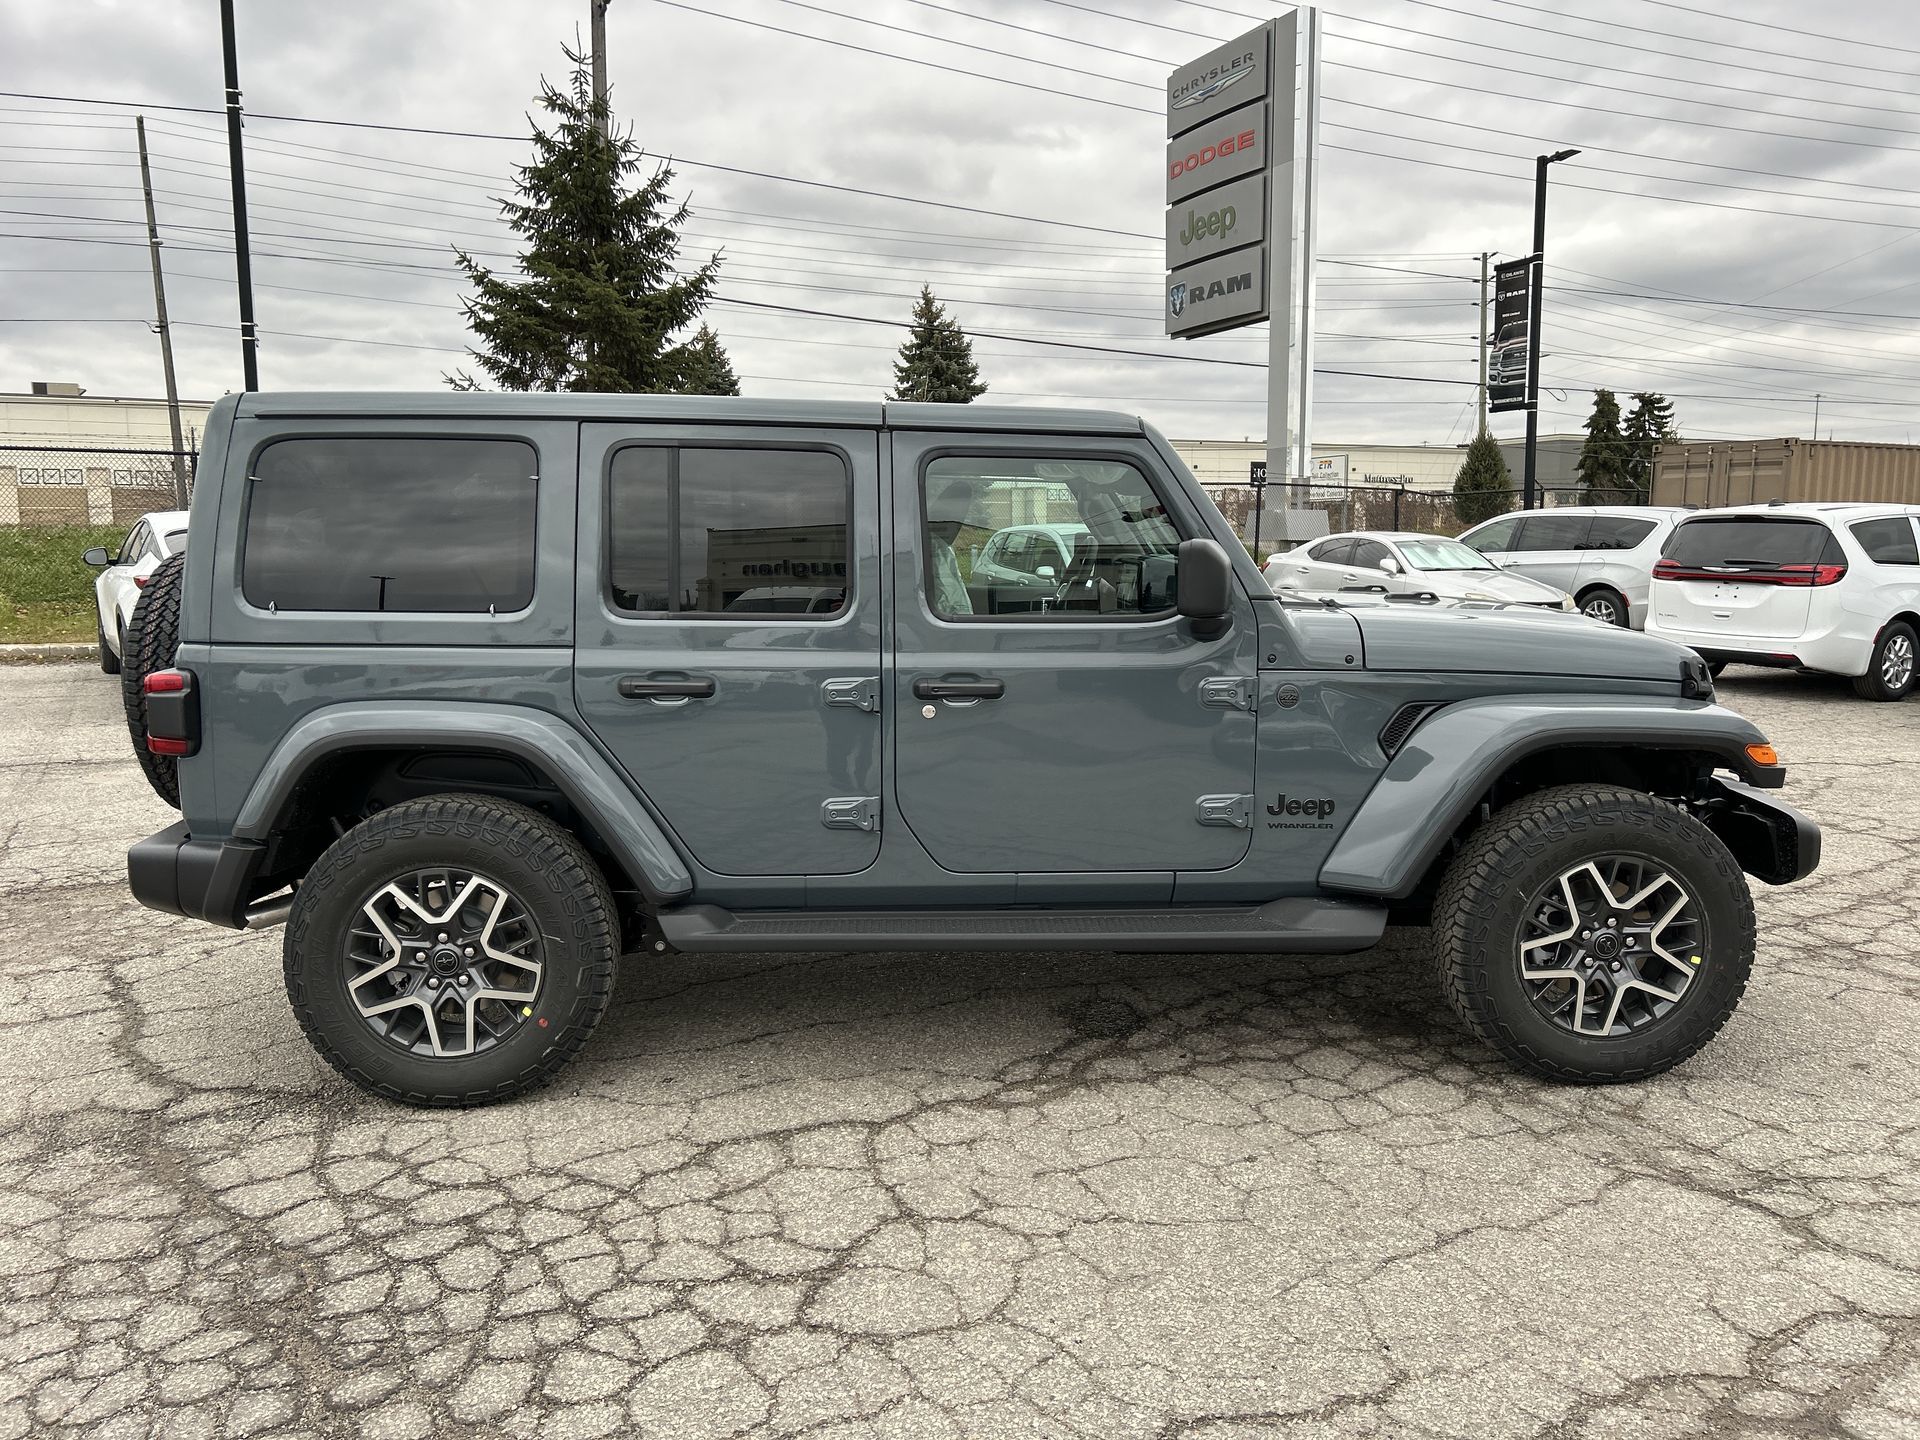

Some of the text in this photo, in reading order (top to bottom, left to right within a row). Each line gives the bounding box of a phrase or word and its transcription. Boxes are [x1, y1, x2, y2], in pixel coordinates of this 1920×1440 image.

[1172, 51, 1255, 99] CHRYSLER
[1170, 129, 1256, 180] DODGE
[1180, 205, 1236, 246] Jeep
[1189, 272, 1252, 304] RAM
[1506, 289, 1526, 298] RAM
[1266, 792, 1335, 820] Jeep
[1267, 822, 1334, 830] WRANGLER
